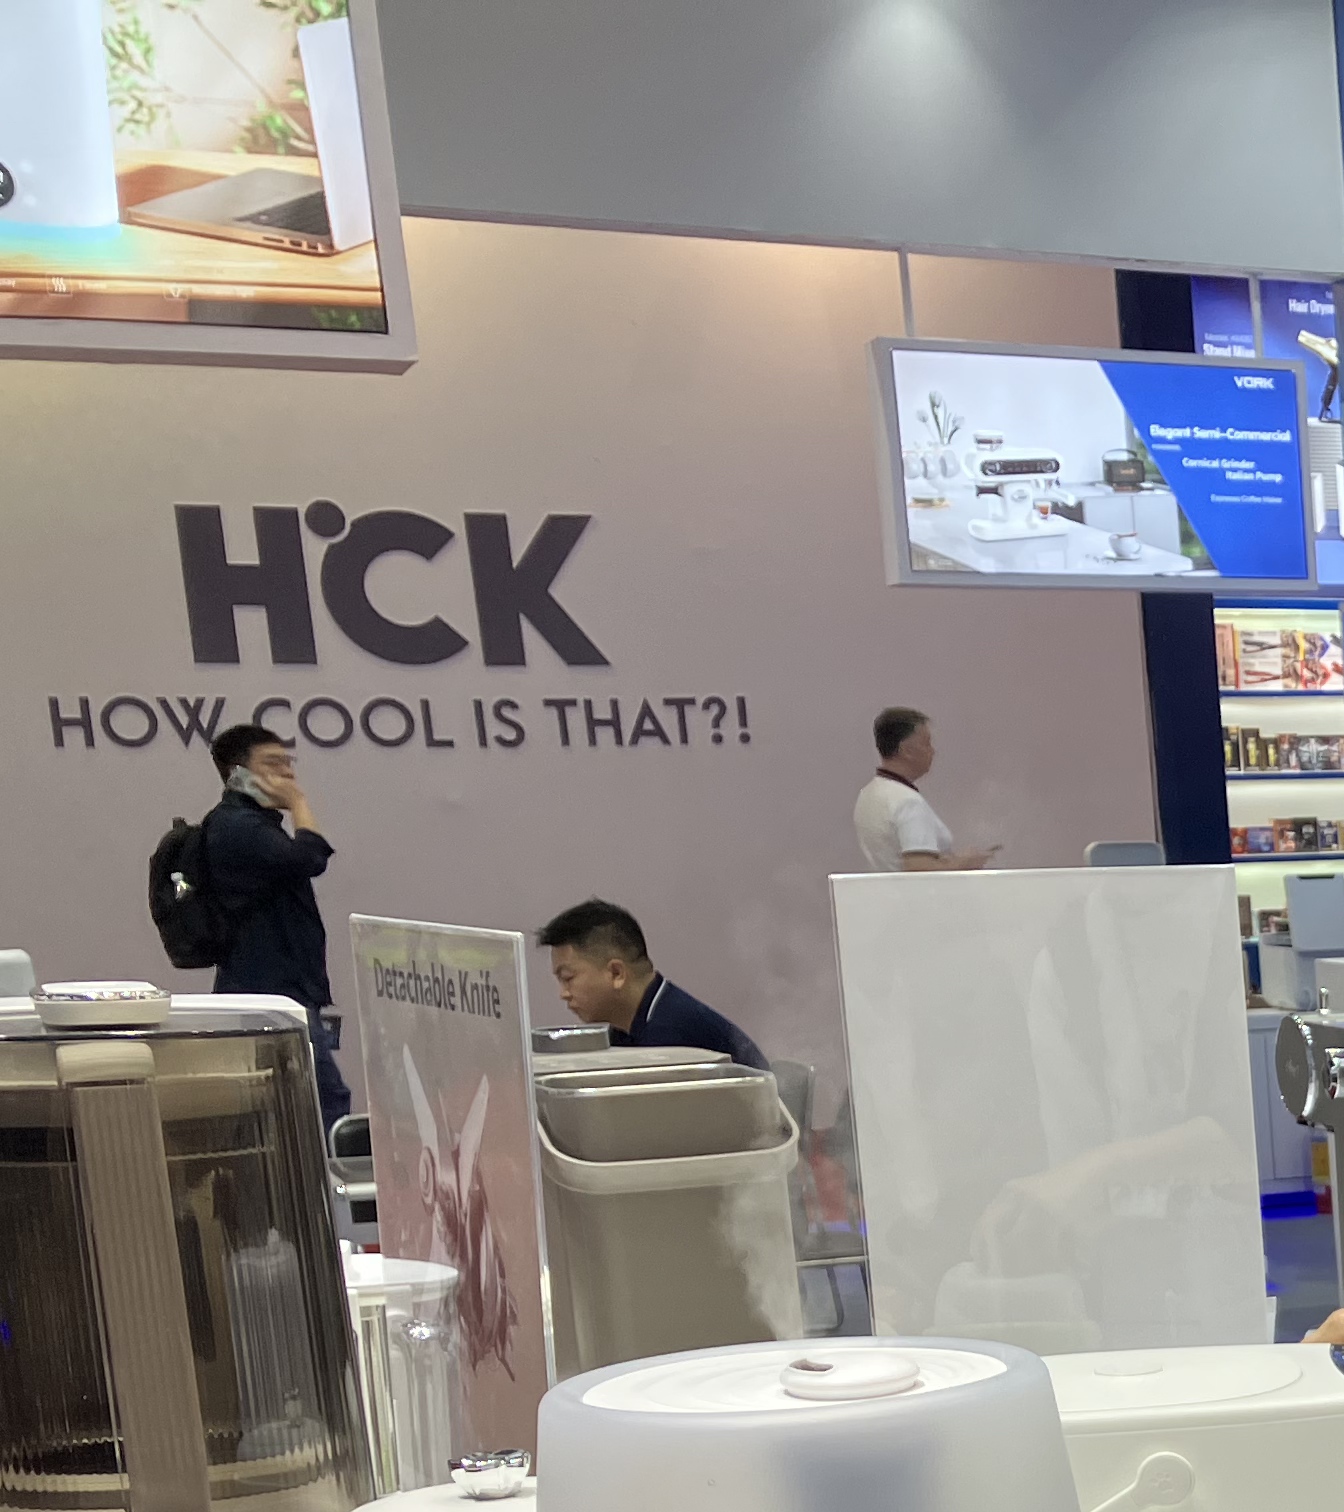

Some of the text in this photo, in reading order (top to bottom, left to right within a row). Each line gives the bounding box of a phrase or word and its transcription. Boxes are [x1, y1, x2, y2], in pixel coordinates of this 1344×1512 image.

[1233, 375, 1275, 390] VORK
[1150, 424, 1191, 440] Elegant
[1221, 458, 1255, 469] Grinder
[1226, 471, 1283, 483] Italian Pump
[48, 696, 226, 749] HOW
[472, 698, 525, 748] IS
[543, 696, 752, 748] THAT?!
[373, 957, 501, 1019] Detachable Knife
